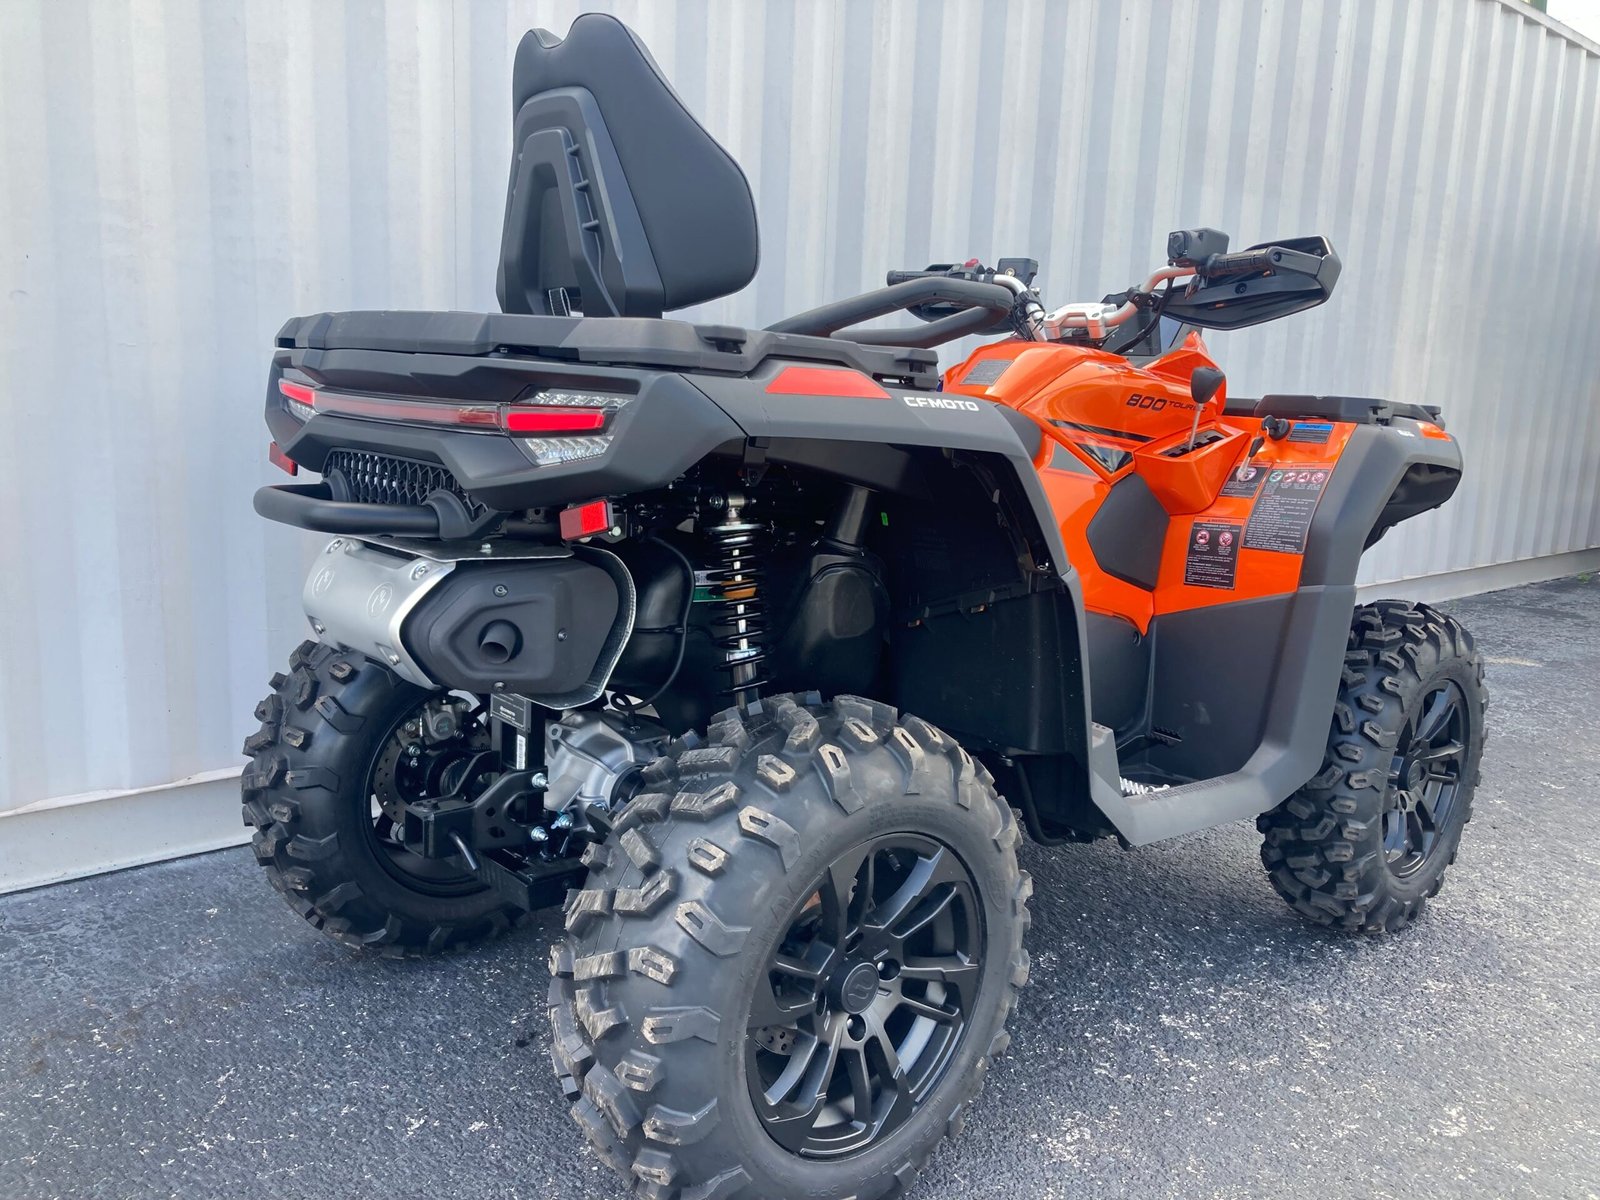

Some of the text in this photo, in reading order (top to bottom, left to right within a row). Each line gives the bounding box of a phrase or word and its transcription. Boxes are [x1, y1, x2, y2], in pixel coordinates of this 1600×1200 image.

[903, 396, 980, 411] CFMOTO
[1126, 393, 1208, 412] 800 TOURIG
